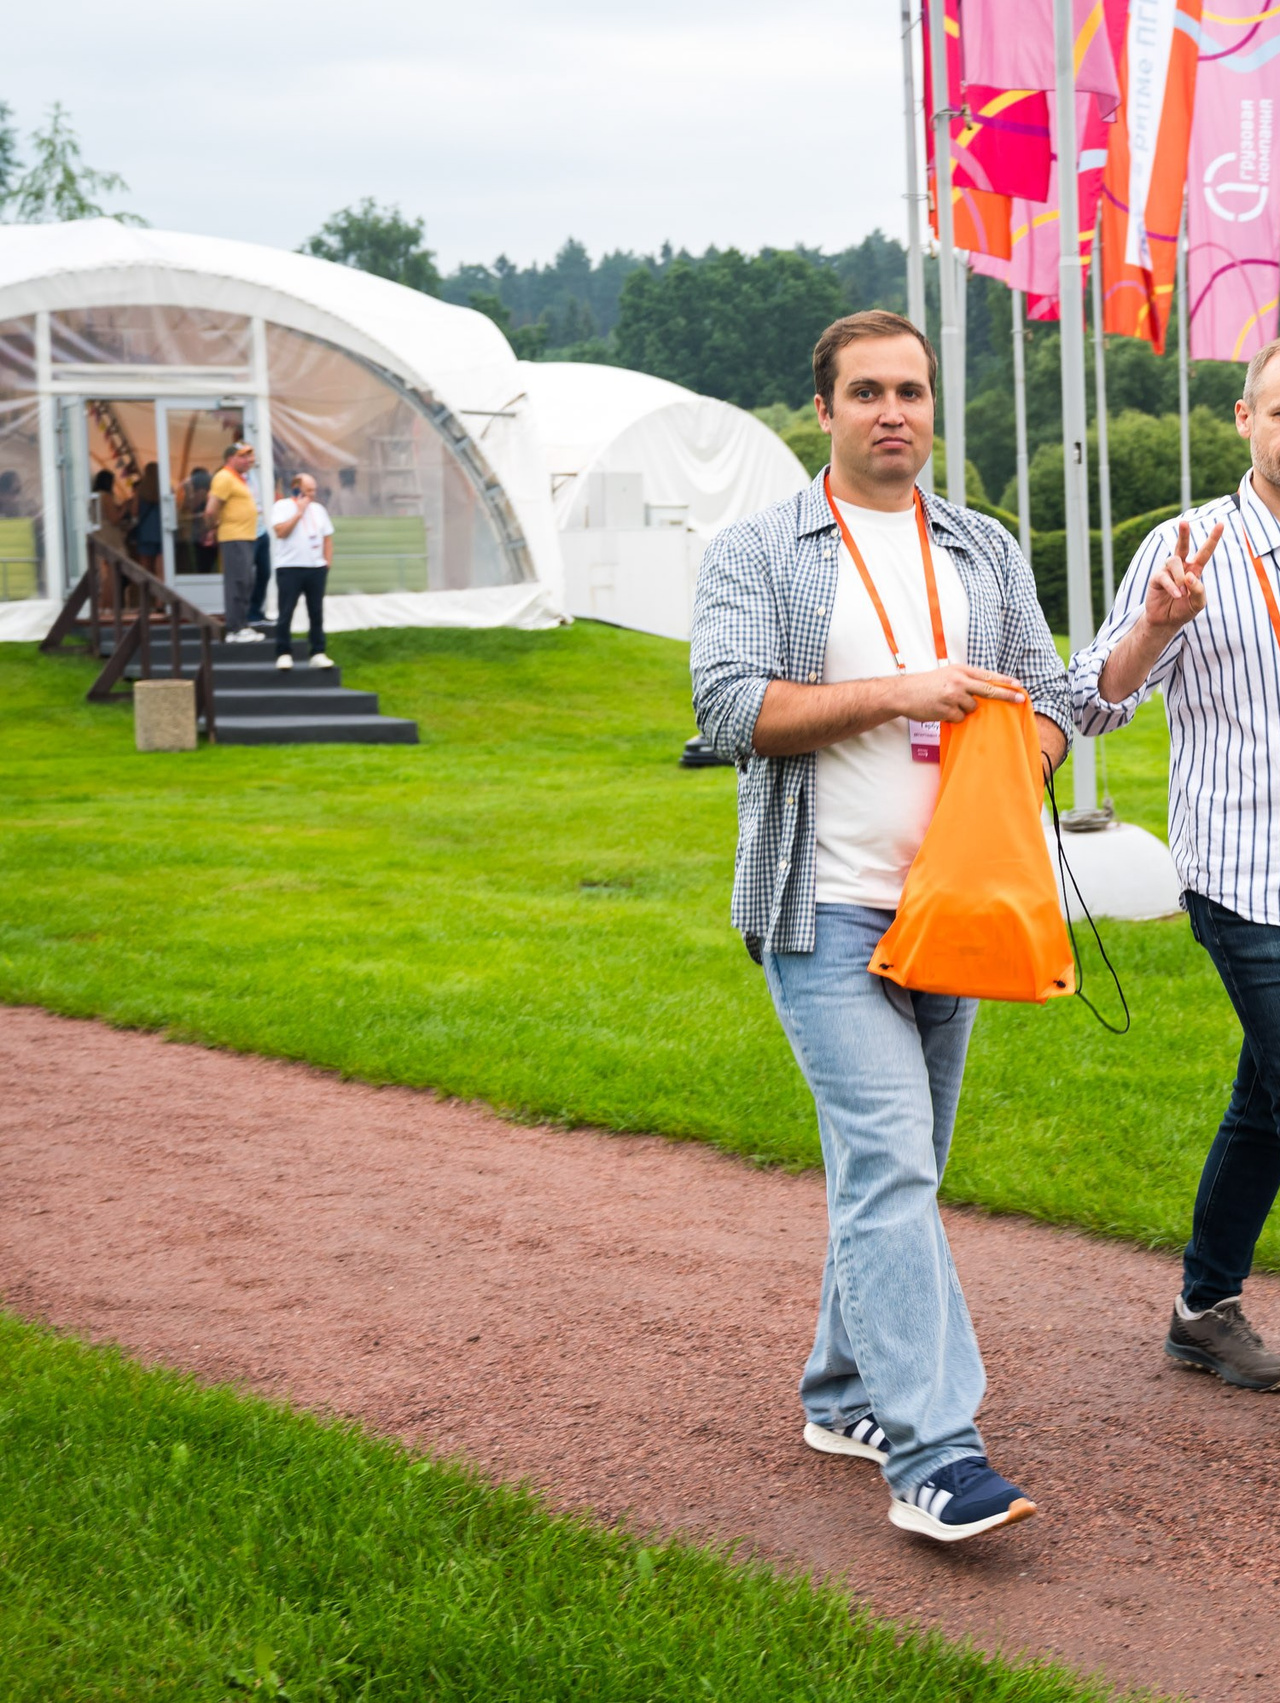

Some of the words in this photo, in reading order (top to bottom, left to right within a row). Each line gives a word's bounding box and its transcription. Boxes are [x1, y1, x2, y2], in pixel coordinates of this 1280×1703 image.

[1135, 0, 1159, 46] ПГ
[1133, 58, 1153, 152] ритме
[1240, 100, 1256, 181] грузовая
[1259, 99, 1273, 182] компания
